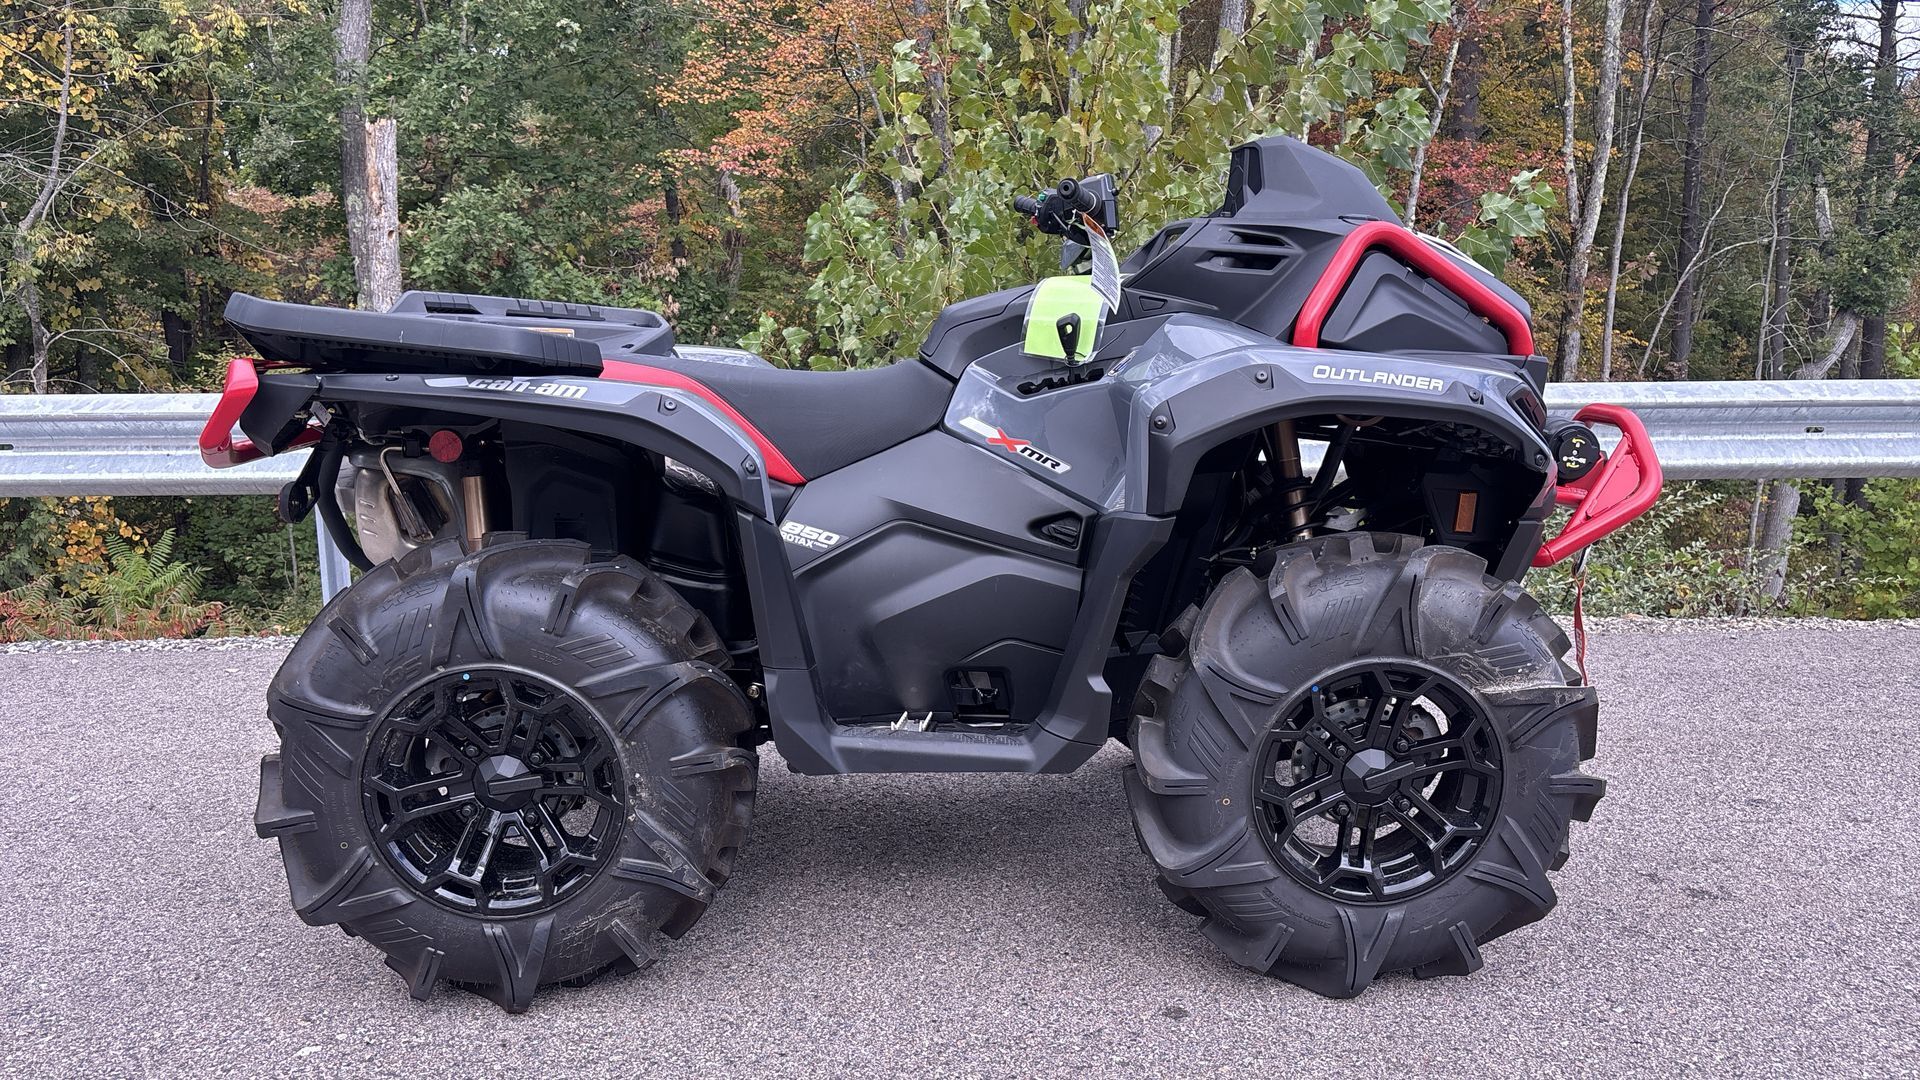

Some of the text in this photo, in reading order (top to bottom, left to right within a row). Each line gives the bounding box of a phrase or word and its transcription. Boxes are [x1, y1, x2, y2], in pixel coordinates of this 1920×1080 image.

[468, 378, 589, 399] can-am
[1312, 364, 1445, 392] OUTLANDER
[781, 520, 841, 545] 850
